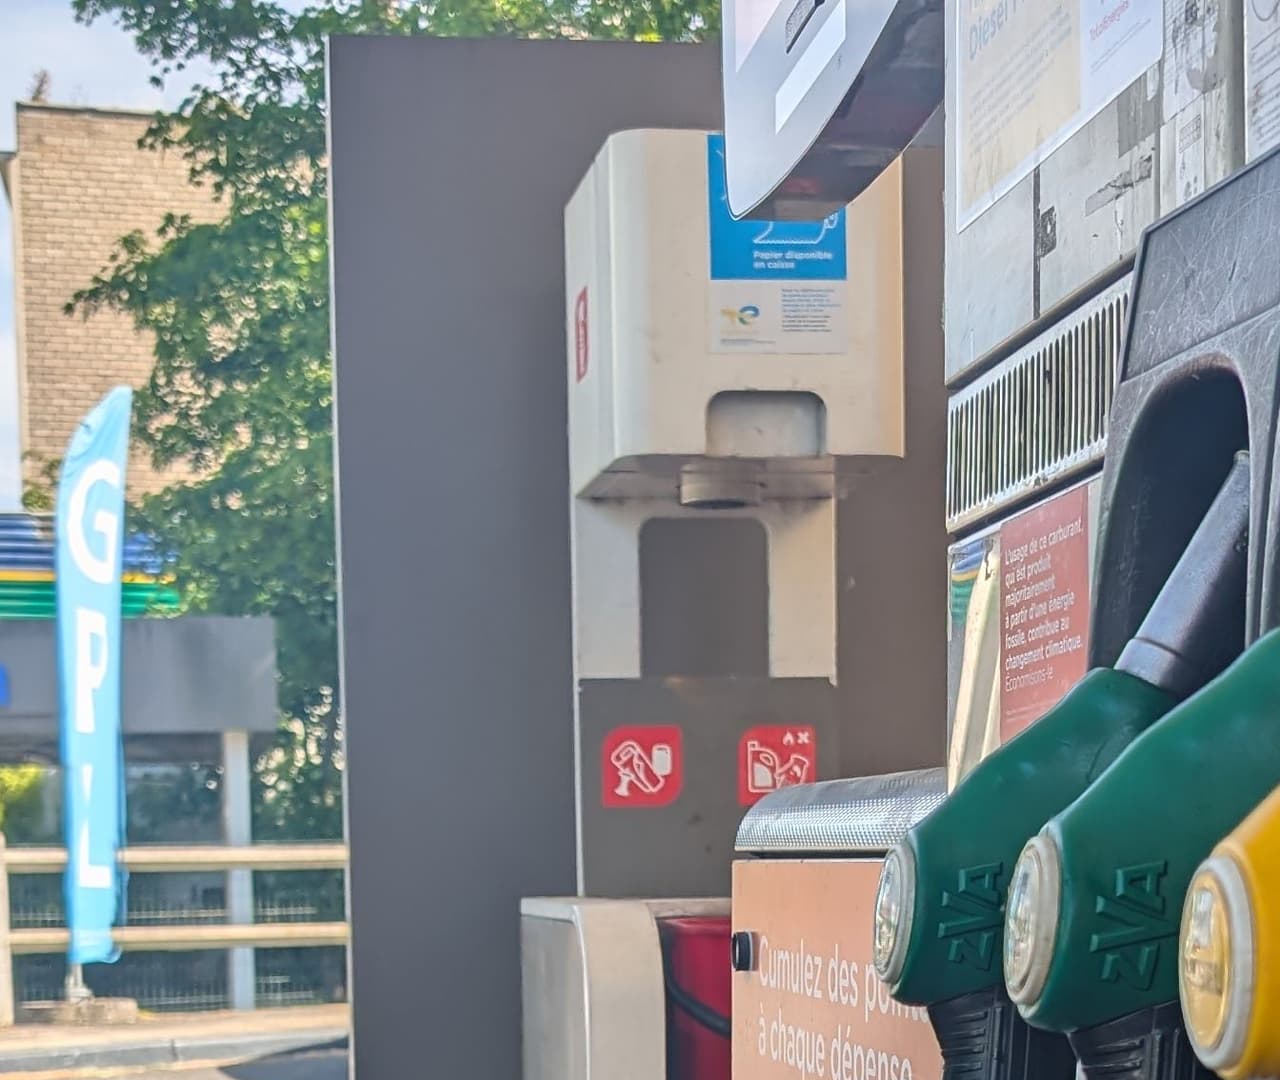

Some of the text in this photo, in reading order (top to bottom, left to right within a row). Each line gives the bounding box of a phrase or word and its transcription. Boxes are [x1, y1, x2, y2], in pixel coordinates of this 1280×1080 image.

[752, 250, 833, 261] Papier disponible
[767, 260, 796, 269] caisse
[1004, 516, 1084, 566] L'usage de ce carburant,
[1005, 552, 1052, 589] qui est produit
[1005, 573, 1056, 608] majoritairement
[1010, 605, 1028, 630] partir
[1028, 602, 1048, 619] d'une
[1048, 588, 1075, 613] énergie
[1028, 619, 1060, 643] contribue
[1060, 616, 1070, 631] au
[1005, 634, 1083, 671] changement climatique.
[758, 935, 823, 999] Cumulez
[827, 943, 859, 1008] des
[758, 1002, 767, 1056] à
